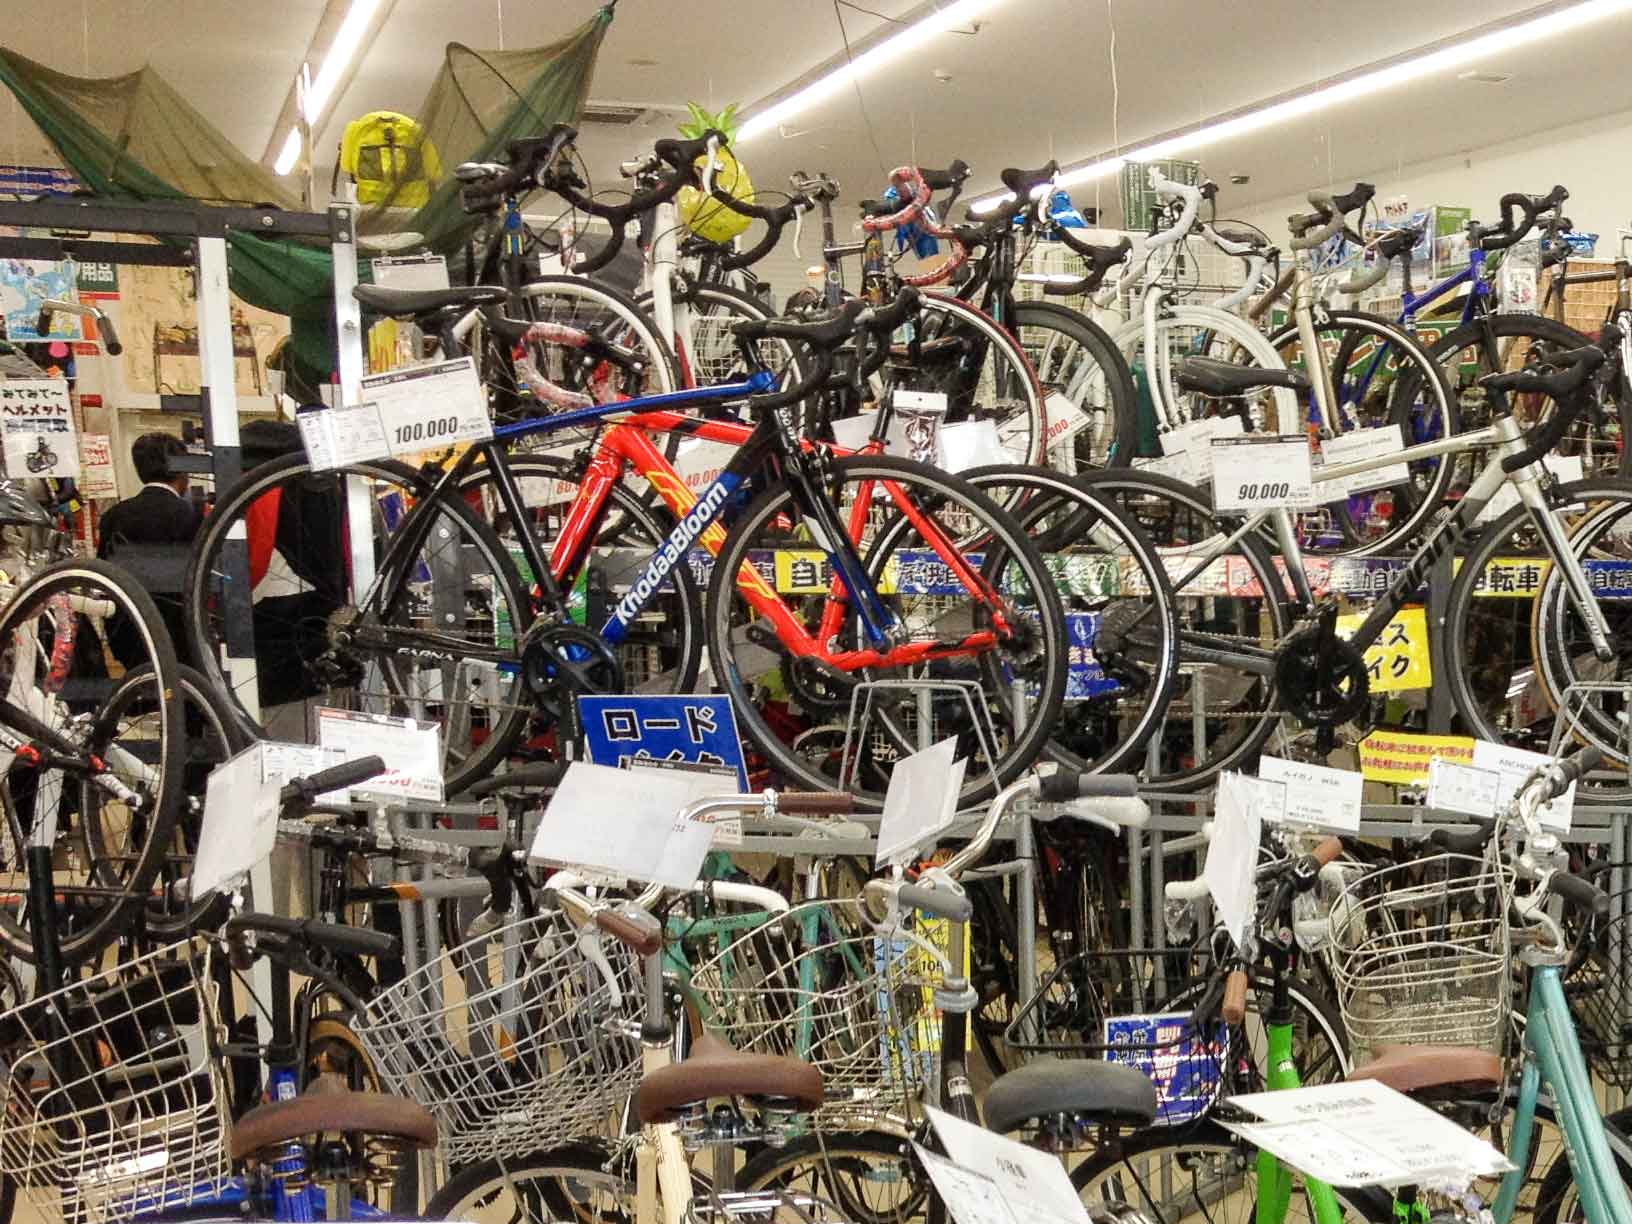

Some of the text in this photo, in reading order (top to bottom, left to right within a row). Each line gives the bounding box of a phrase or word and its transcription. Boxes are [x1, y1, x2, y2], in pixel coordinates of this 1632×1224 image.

[1238, 483, 1290, 500] 90,000
[615, 481, 729, 627] KhodaaBloom
[602, 705, 718, 744] ロード
